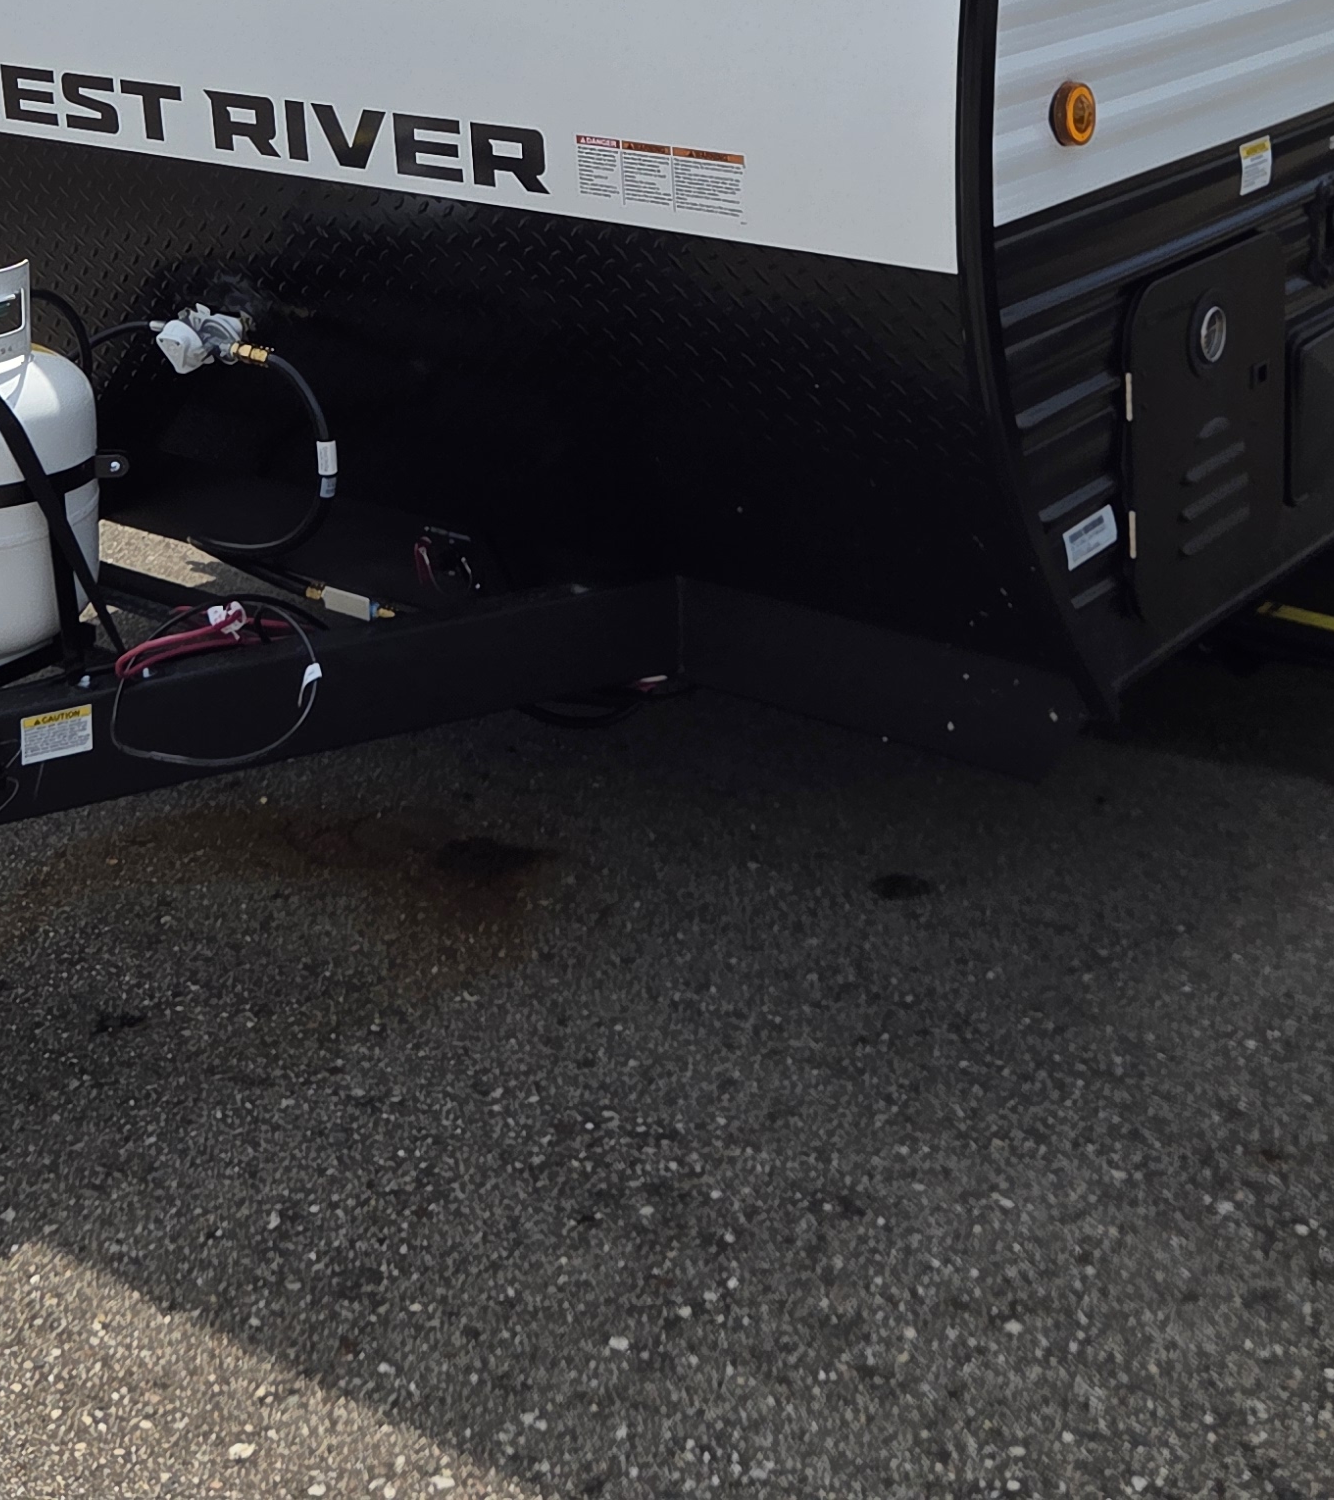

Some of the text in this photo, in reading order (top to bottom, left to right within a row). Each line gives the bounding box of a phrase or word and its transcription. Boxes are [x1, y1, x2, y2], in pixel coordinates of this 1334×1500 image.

[202, 88, 552, 195] RIVER
[586, 136, 617, 148] DANGER
[41, 710, 81, 725] CAUTION
